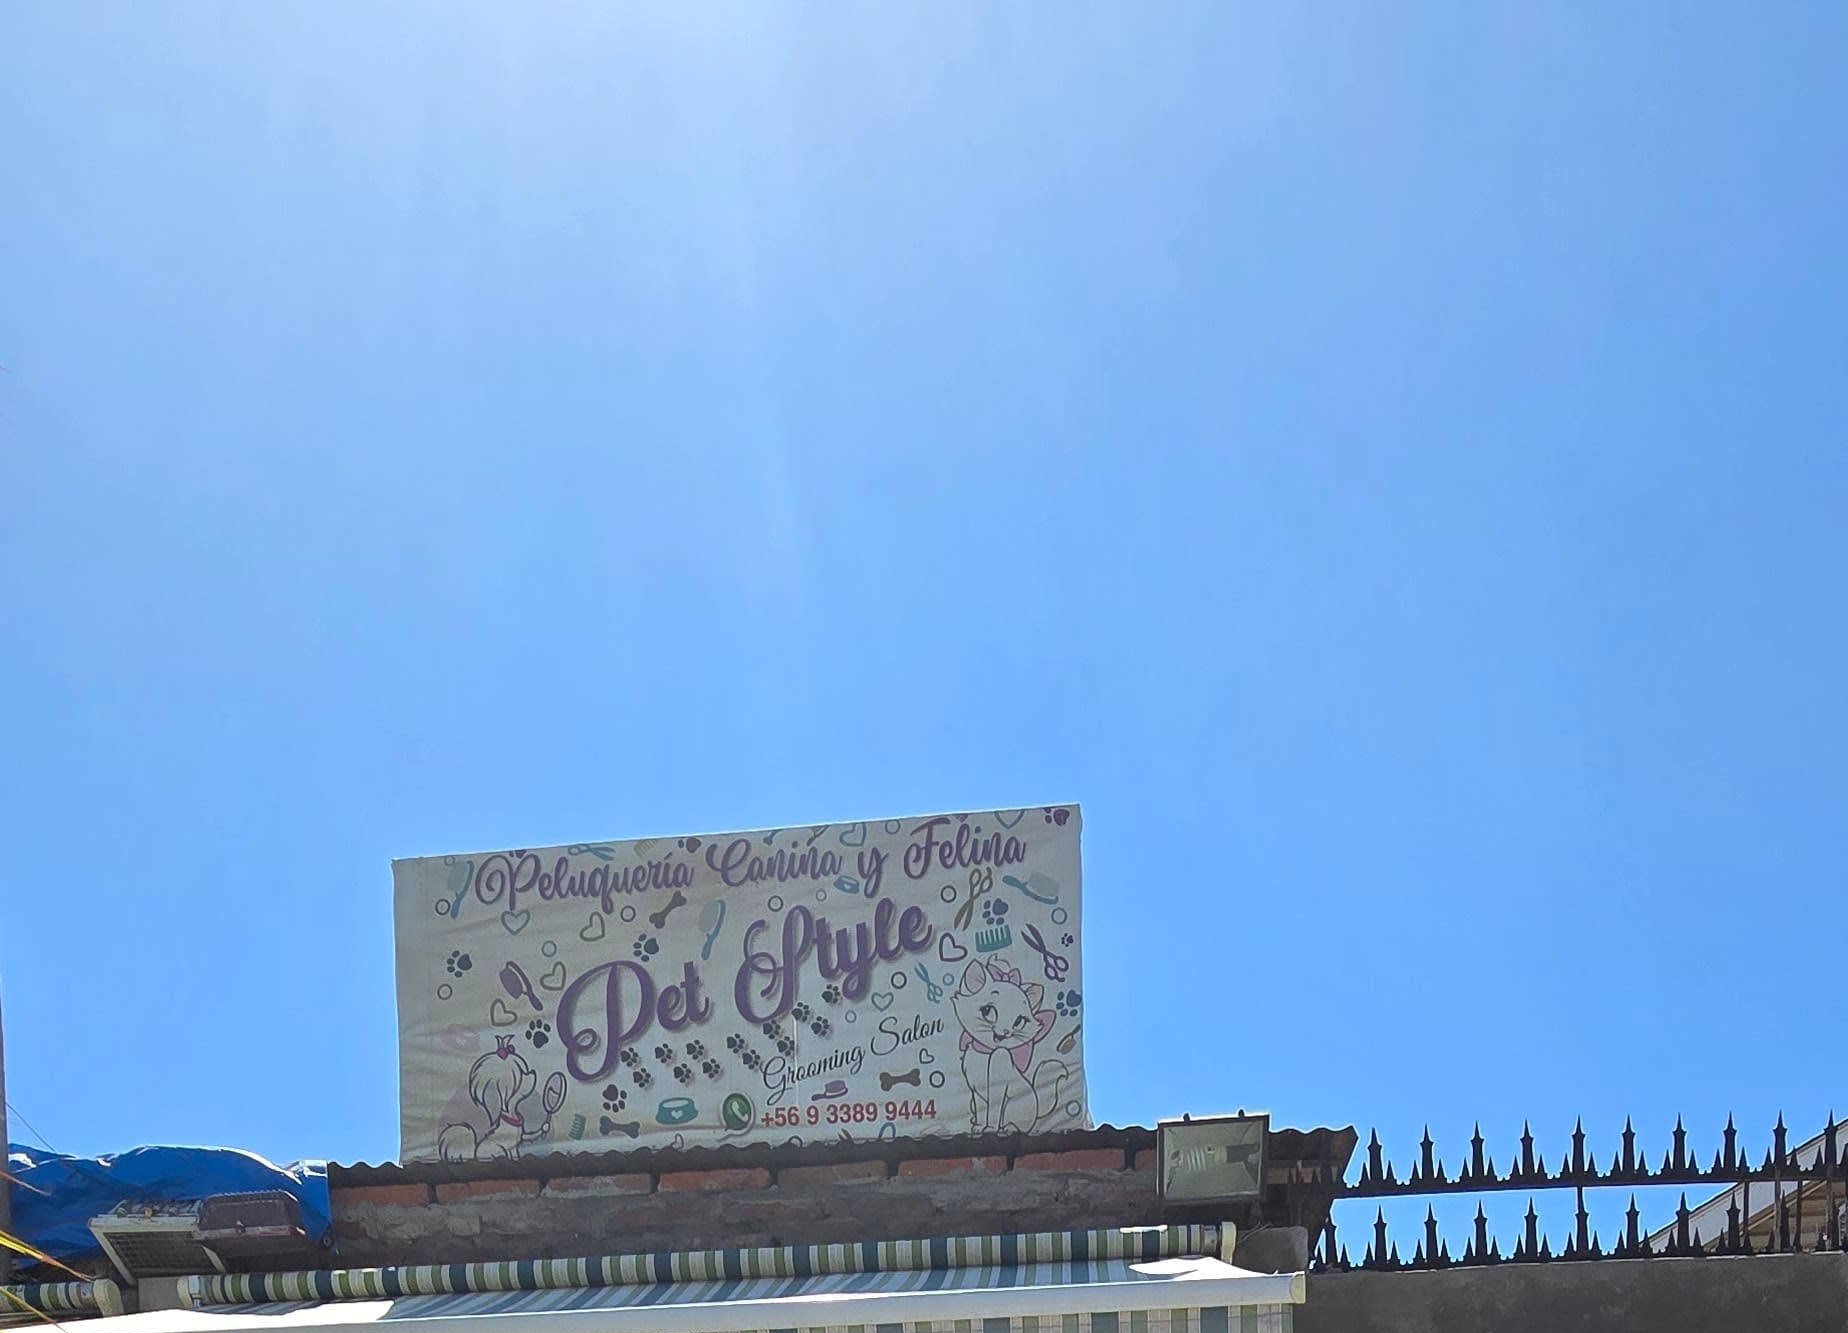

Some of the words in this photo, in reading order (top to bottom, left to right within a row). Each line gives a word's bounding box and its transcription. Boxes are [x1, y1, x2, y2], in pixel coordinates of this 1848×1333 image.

[475, 851, 695, 915] Peluquería
[705, 838, 842, 887] Canina
[857, 847, 889, 899] y
[903, 816, 1026, 880] Felina
[556, 958, 713, 1082] Pet
[734, 897, 933, 1025] Style
[761, 1046, 866, 1106] Grooming
[870, 1014, 944, 1056] Salon
[761, 1106, 800, 1128] +56
[806, 1105, 820, 1125] 9
[826, 1102, 878, 1124] 3389
[885, 1099, 937, 1121] 9444
